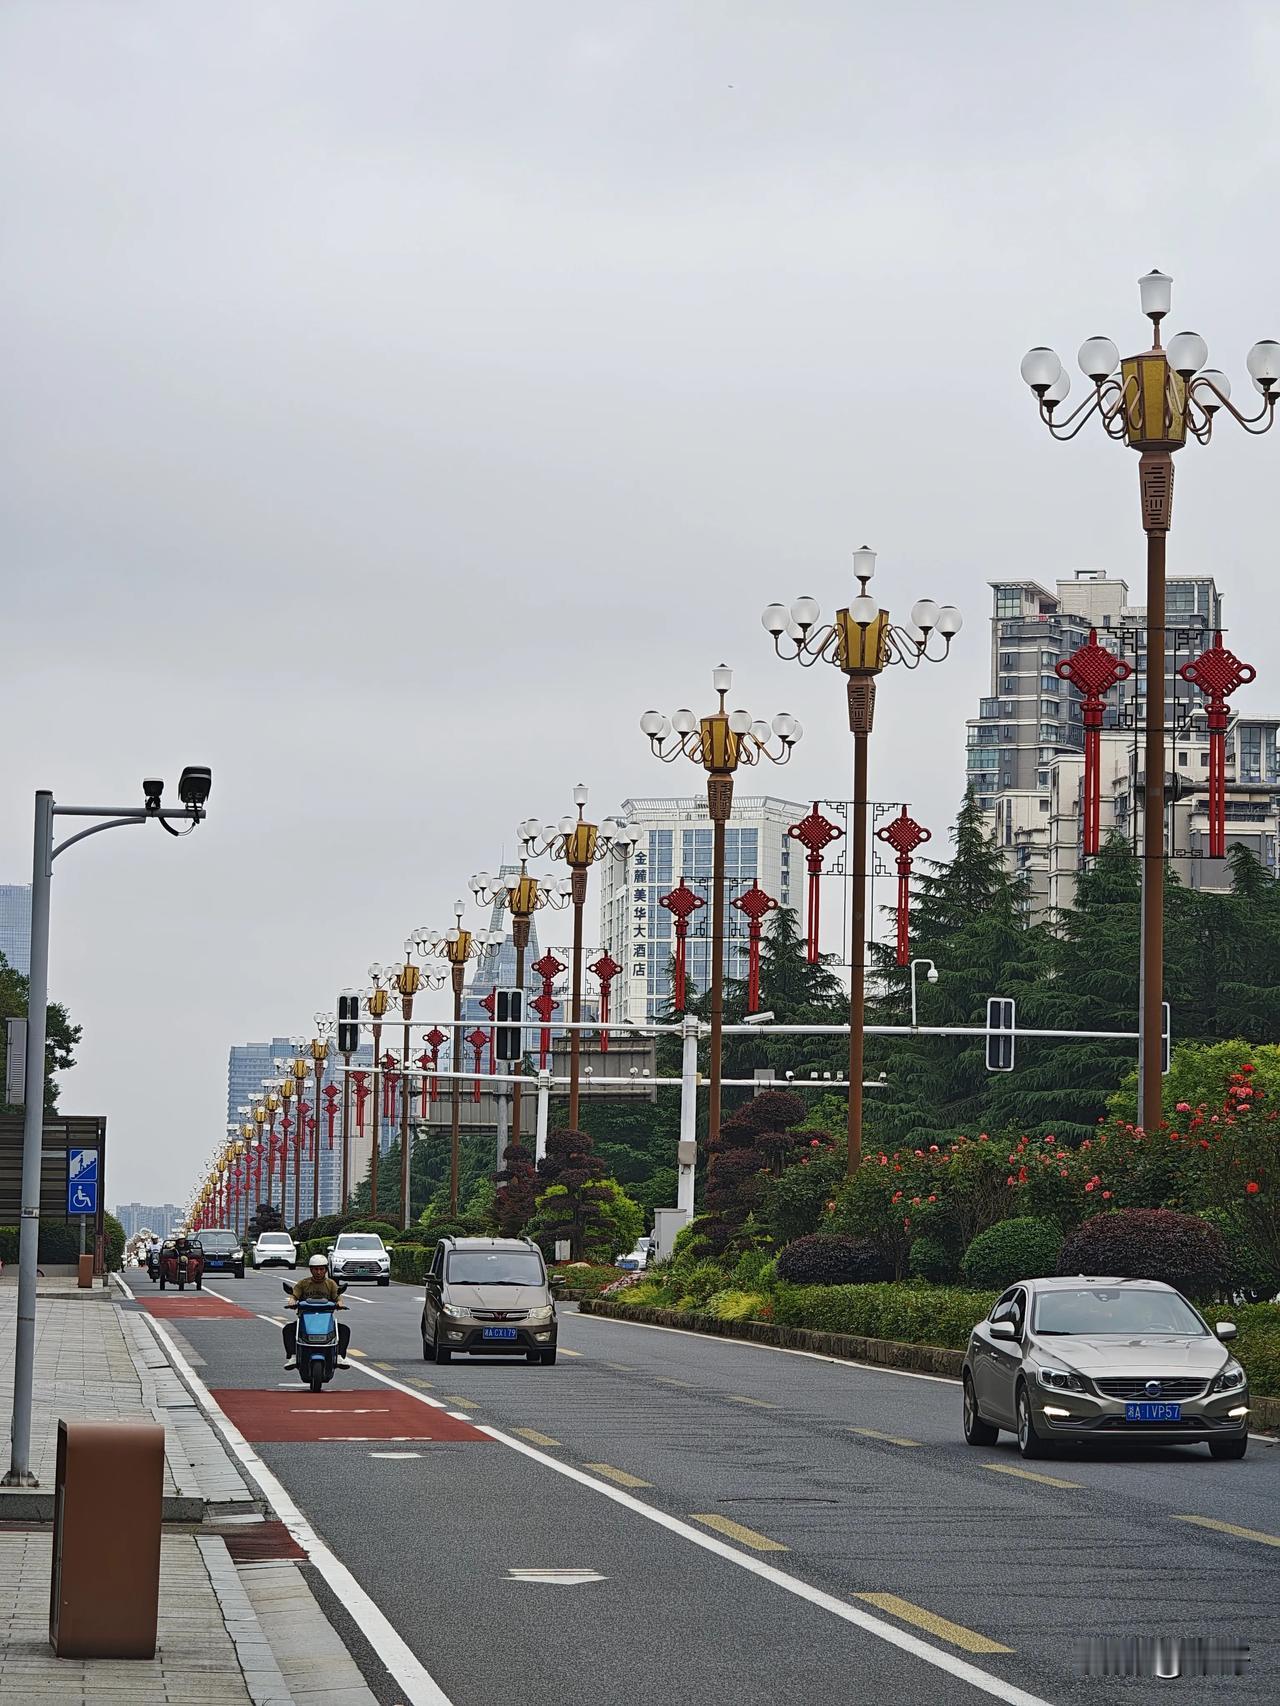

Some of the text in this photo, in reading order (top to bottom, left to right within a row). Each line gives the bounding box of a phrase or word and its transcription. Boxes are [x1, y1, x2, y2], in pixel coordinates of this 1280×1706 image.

[633, 851, 647, 976] 金麓美华大酒店
